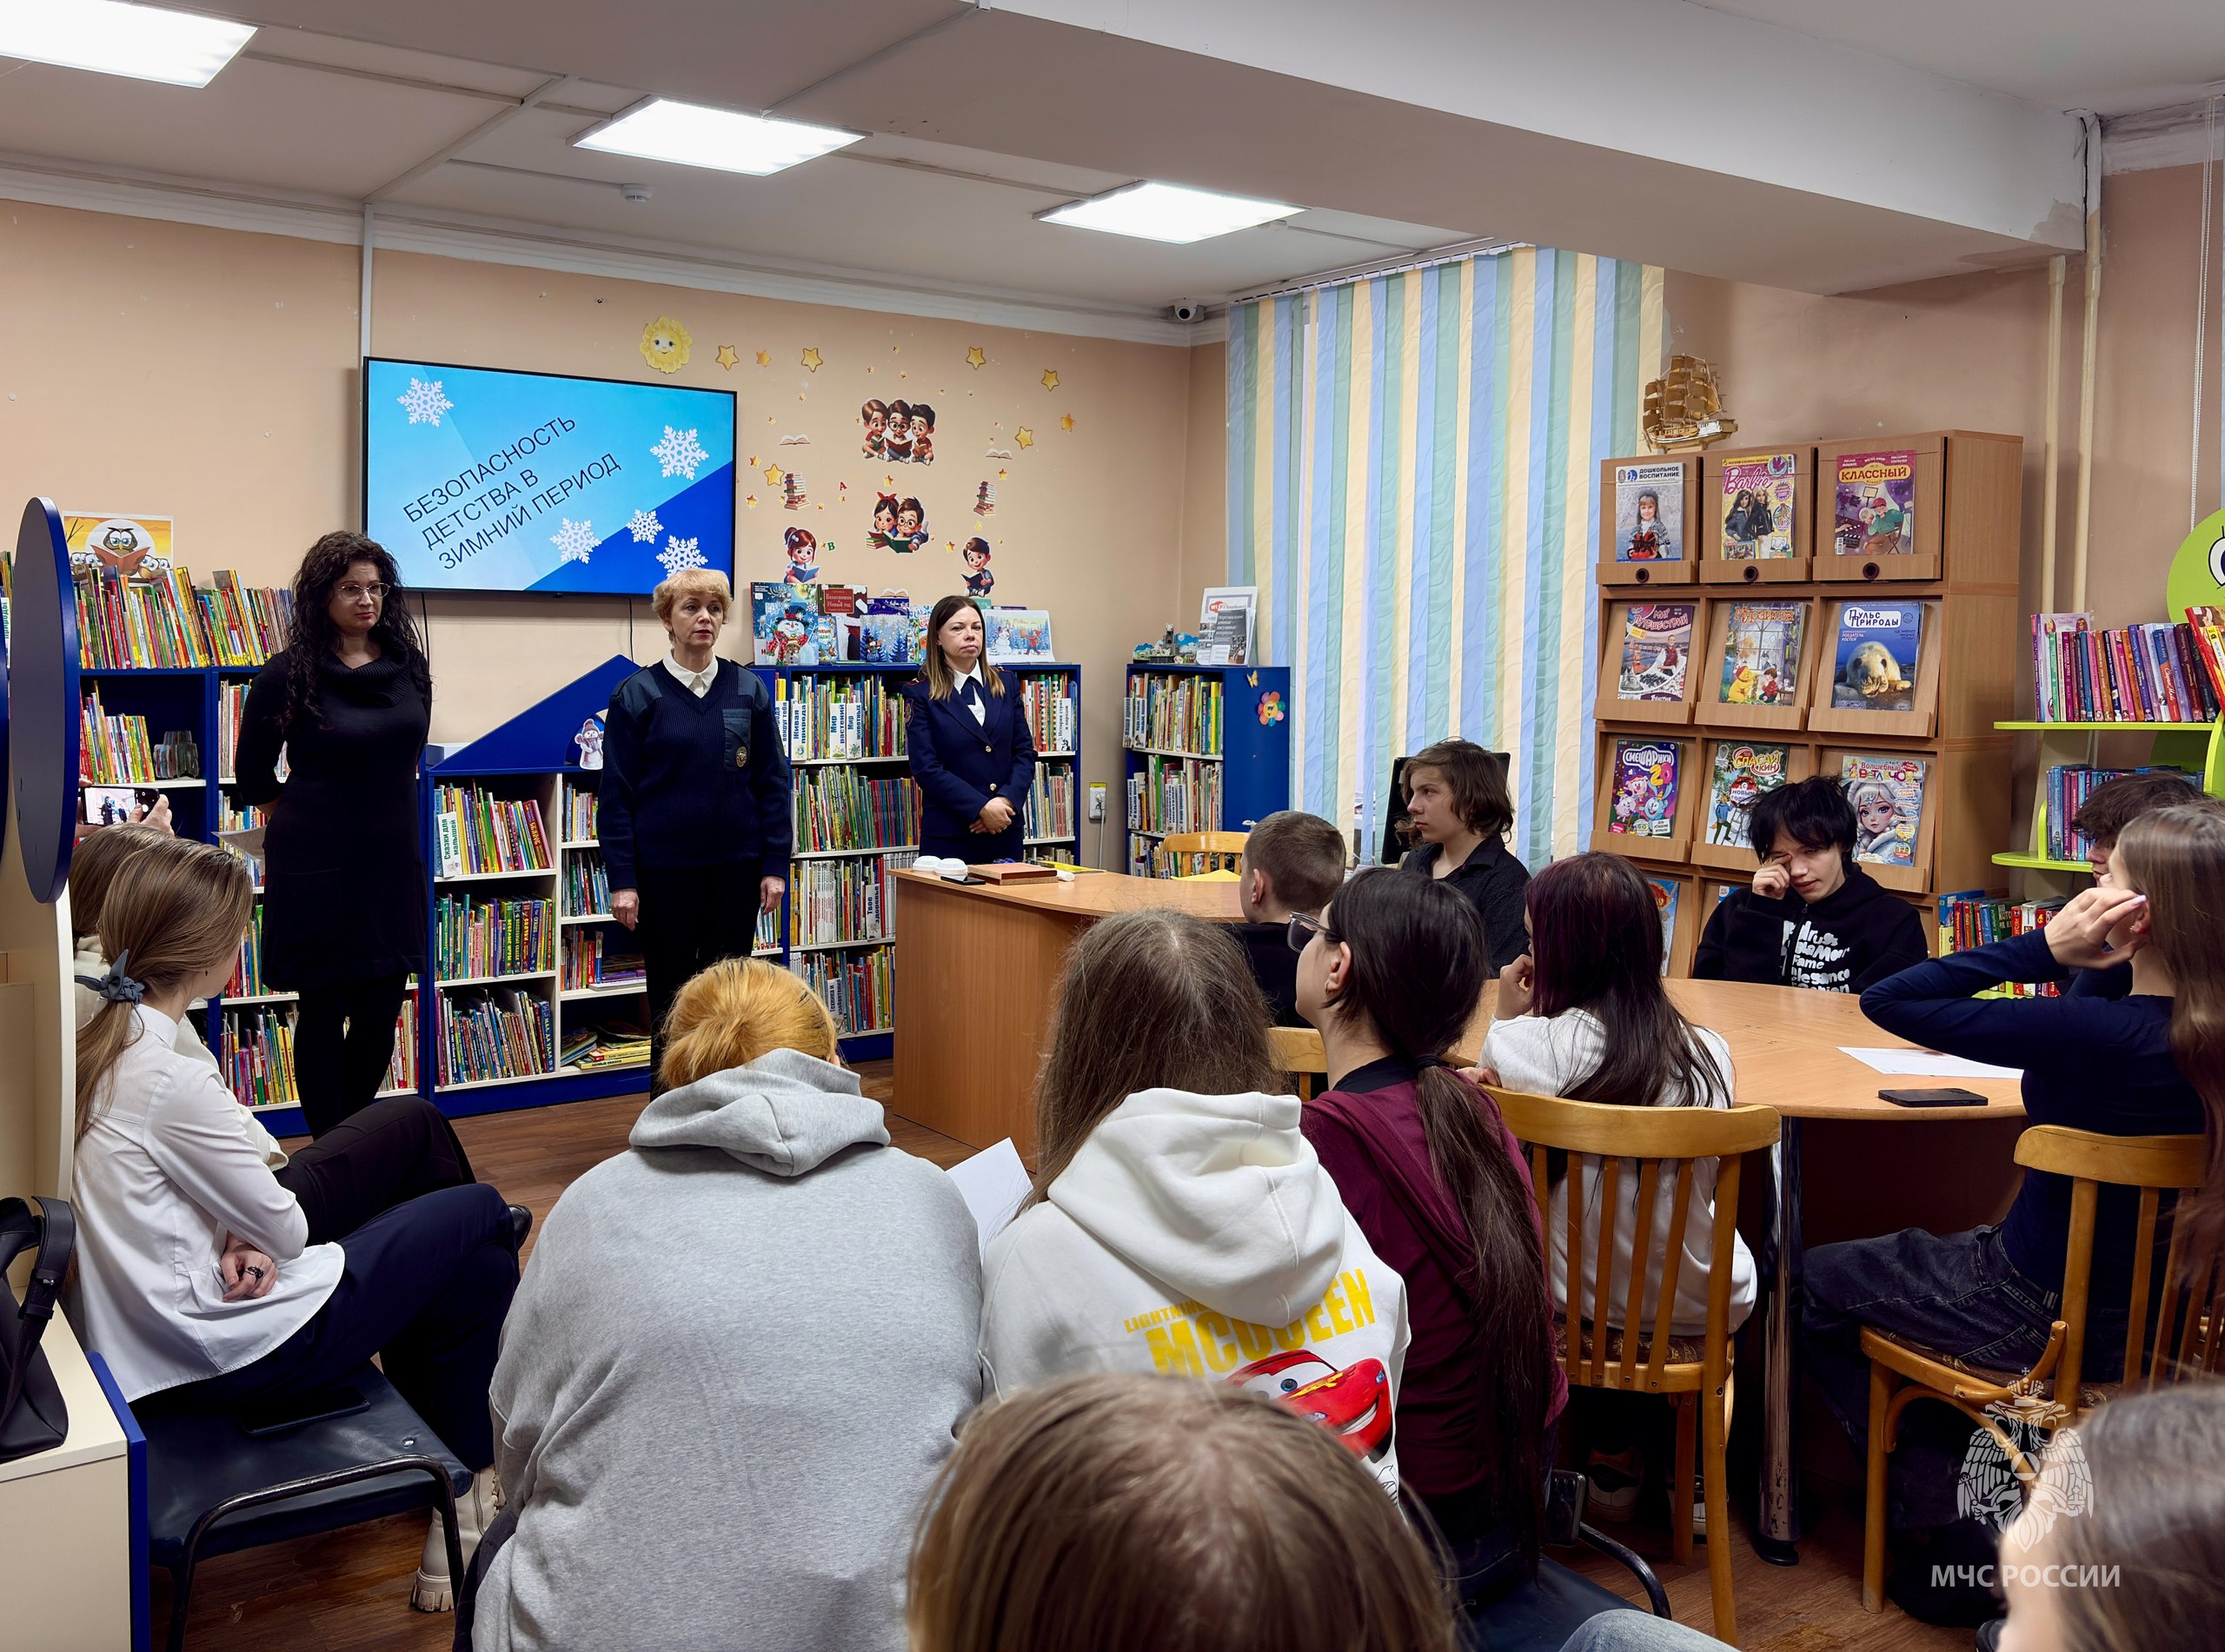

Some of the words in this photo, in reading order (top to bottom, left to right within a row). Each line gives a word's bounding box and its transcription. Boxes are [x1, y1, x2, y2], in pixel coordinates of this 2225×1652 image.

[402, 415, 577, 523] БЕЗОПАСНОСТЬ
[1724, 466, 1773, 495] Barbie
[1841, 467, 1907, 480] КЛАССНЫЙ
[421, 482, 521, 550] ДЕТСТВА
[520, 468, 539, 489] В
[438, 505, 533, 570] ЗИМНИЙ
[531, 453, 622, 516] ПЕРИОД
[1653, 608, 1670, 620] МИР
[1625, 750, 1671, 766] СМЕШАРИКИ
[1734, 751, 1780, 767] СПАСАЙ
[1861, 761, 1901, 771] Волшебный
[1650, 762, 1673, 786] 20
[450, 819, 459, 856] малышей
[1792, 954, 1824, 970] Fame
[1124, 1300, 1208, 1334] LIGHTNIN
